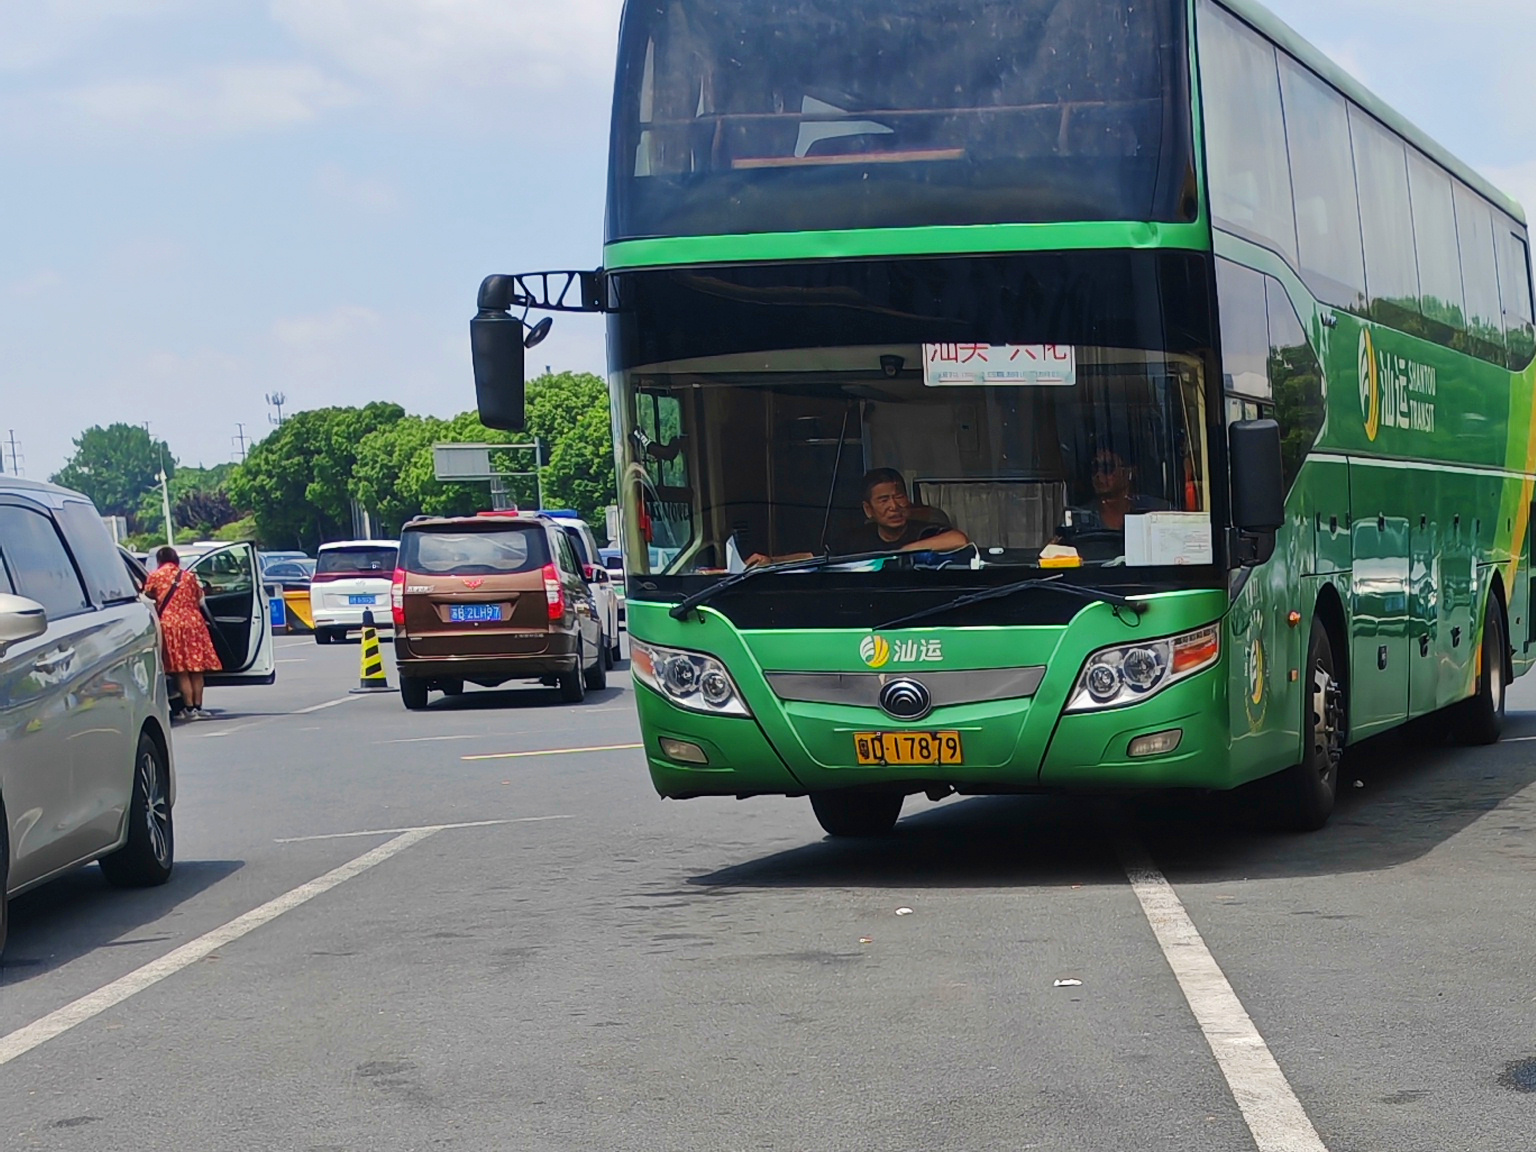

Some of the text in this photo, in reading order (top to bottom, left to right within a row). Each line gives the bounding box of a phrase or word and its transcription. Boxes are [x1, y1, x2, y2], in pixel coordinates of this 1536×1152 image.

[1379, 349, 1410, 430] 汕运
[1408, 359, 1436, 396] SHANTOU
[1409, 399, 1435, 433] TRANSIT
[893, 639, 943, 662] 汕运
